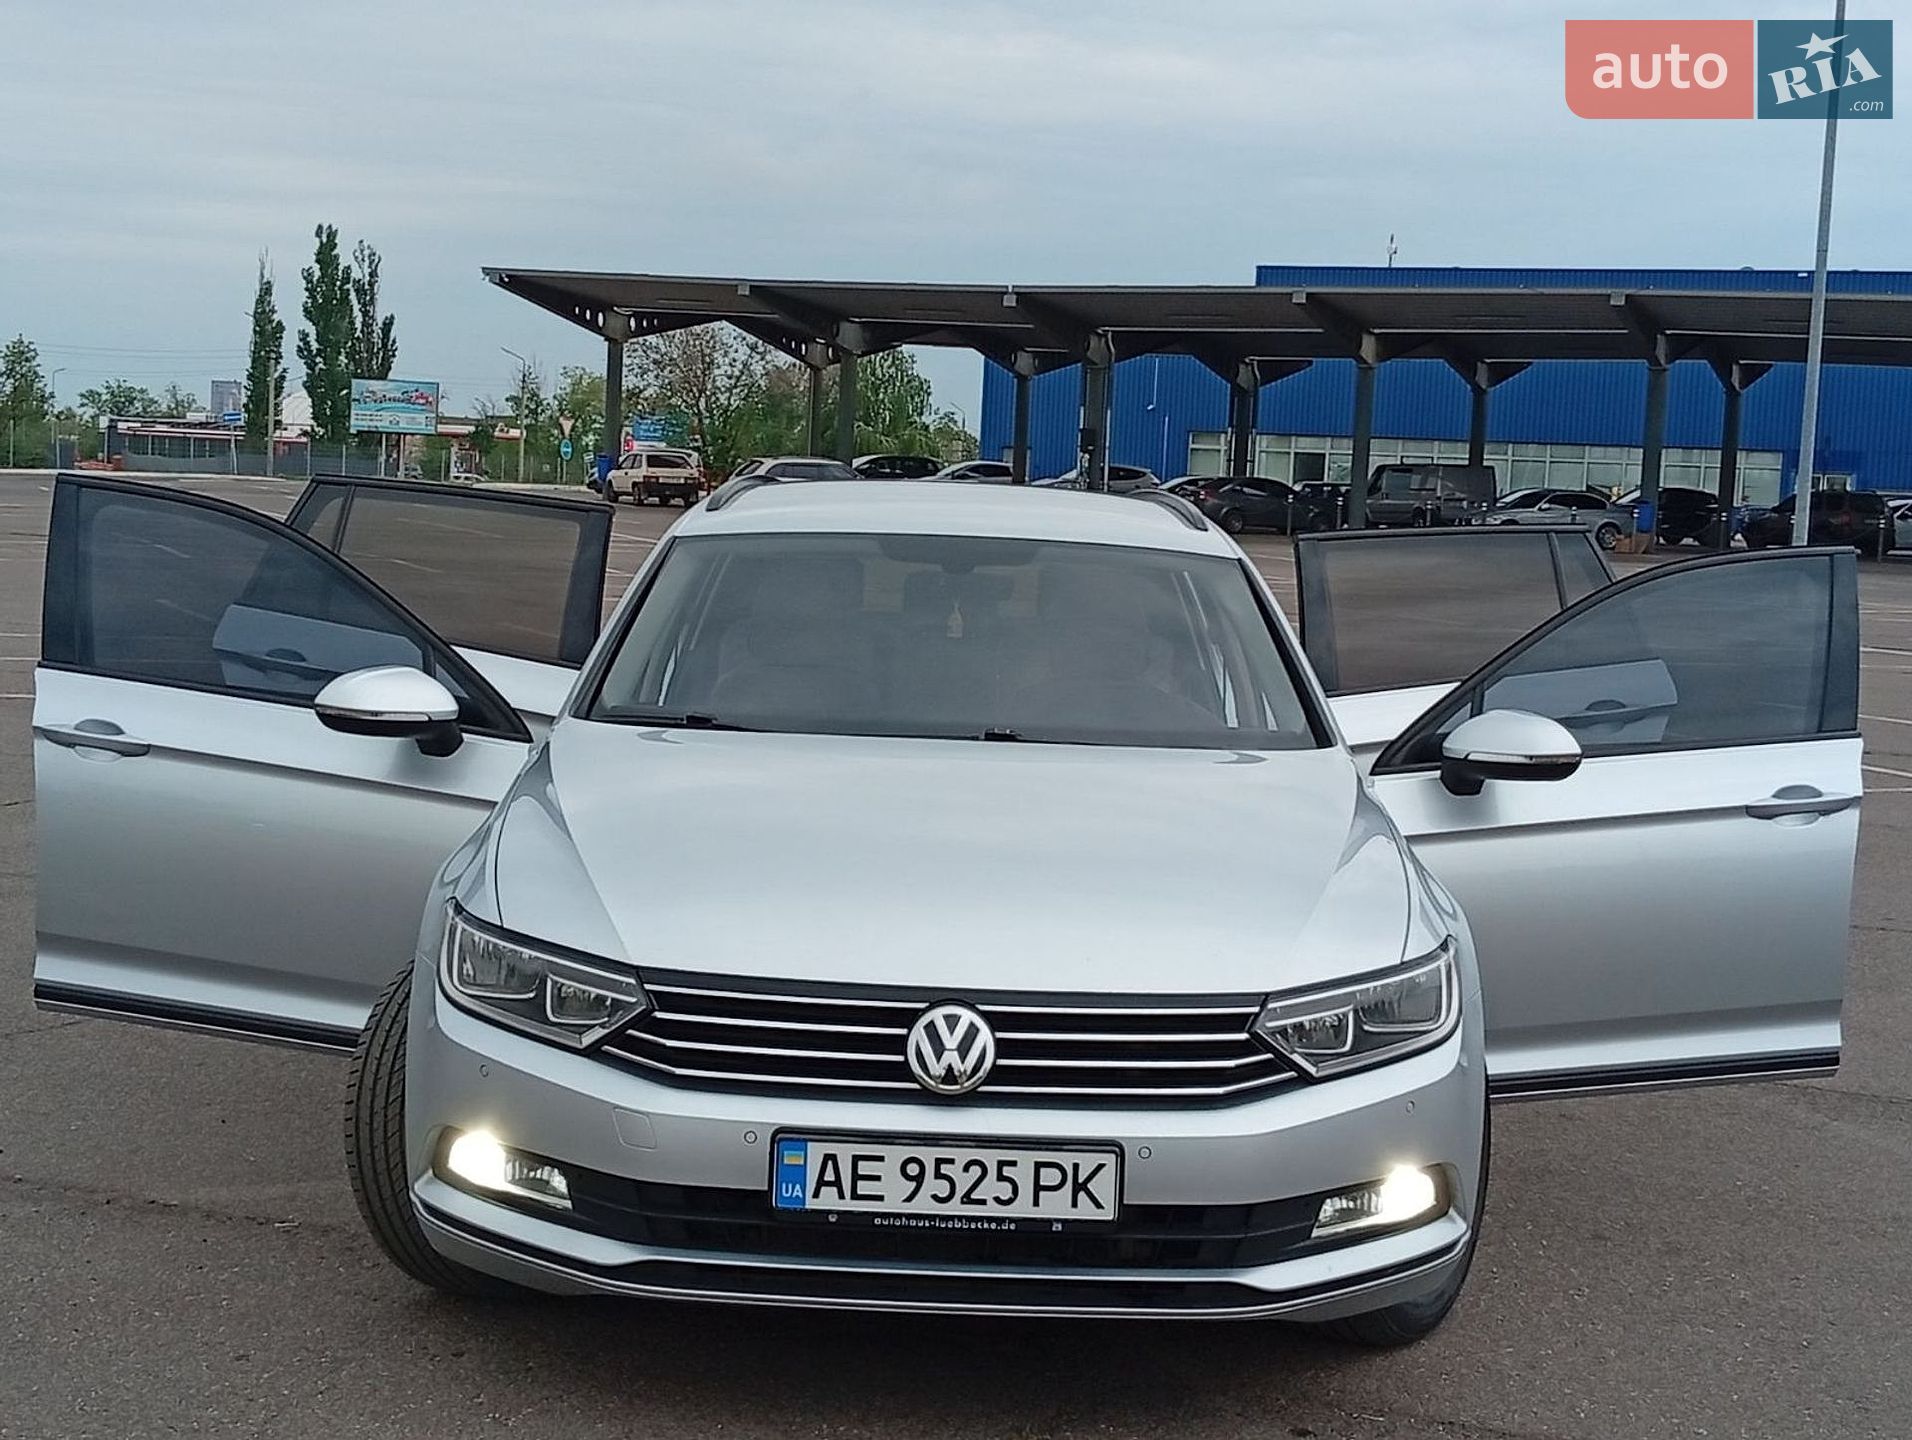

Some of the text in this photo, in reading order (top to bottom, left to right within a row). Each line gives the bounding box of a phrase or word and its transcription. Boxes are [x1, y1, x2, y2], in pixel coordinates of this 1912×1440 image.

[782, 1182, 803, 1198] UA
[811, 1152, 1108, 1210] AE 9525 PK
